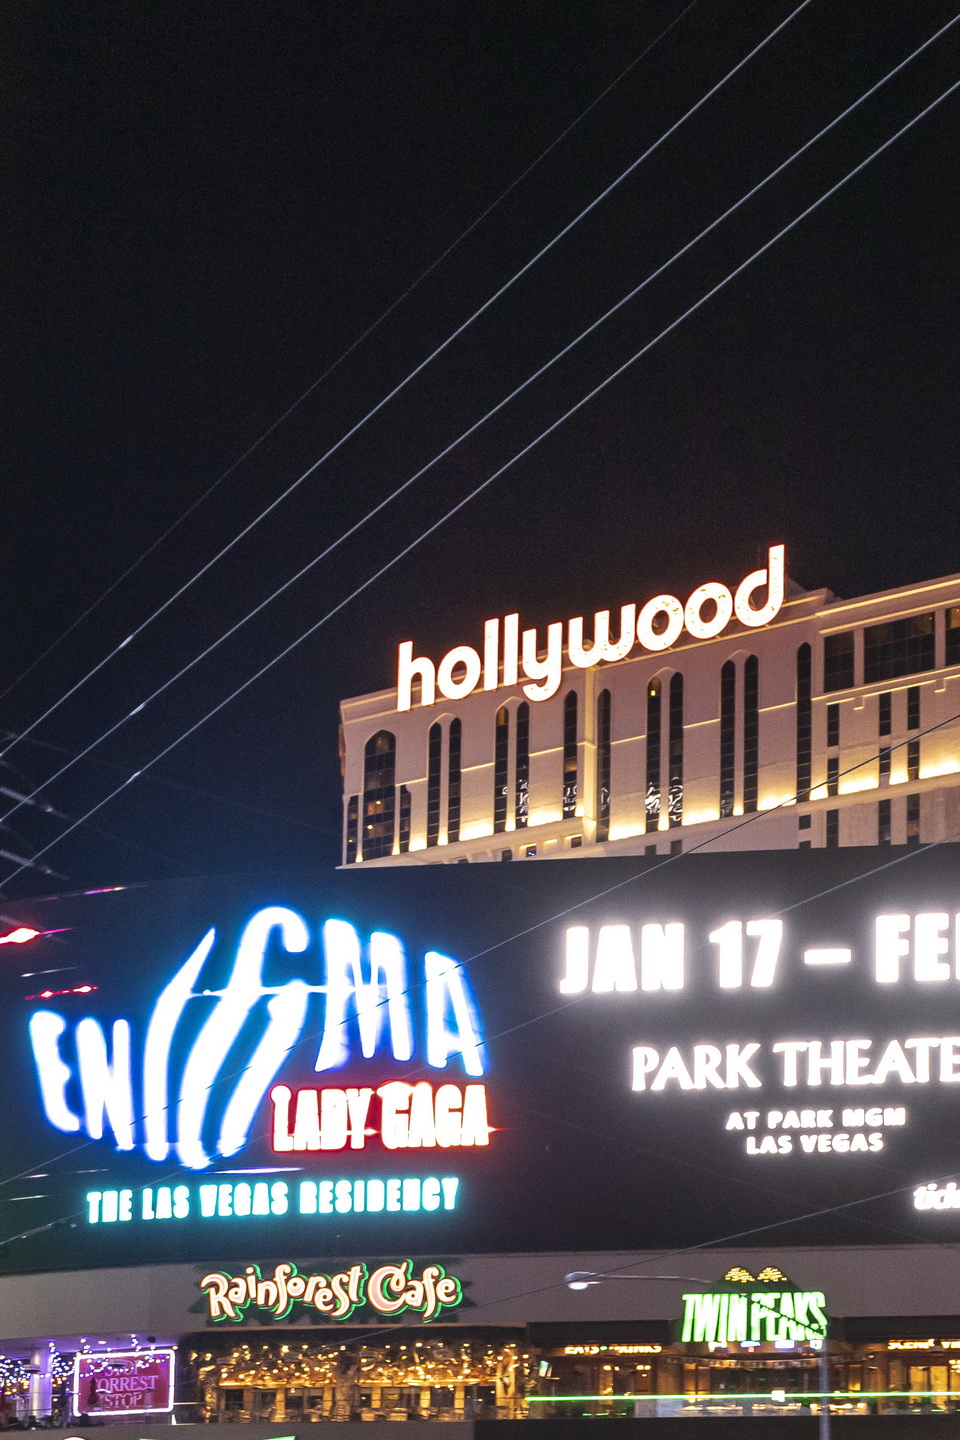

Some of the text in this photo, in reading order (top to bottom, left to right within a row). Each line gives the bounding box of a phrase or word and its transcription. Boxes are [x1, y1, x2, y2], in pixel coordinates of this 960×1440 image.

[396, 543, 786, 711] hollywood
[558, 922, 686, 994] JAN
[709, 918, 784, 989] 17
[631, 1042, 762, 1092] PARK
[270, 1081, 489, 1152] LADY GAGA
[725, 1107, 906, 1131] AT PARK MGM
[746, 1133, 884, 1154] LAS VEGAS
[87, 1177, 459, 1223] THE LAS VEGAS RESIDENCY
[200, 1258, 463, 1322] Rainforest Cafe
[682, 1291, 828, 1342] TWIN PEAKS
[94, 1375, 159, 1393] ORREST
